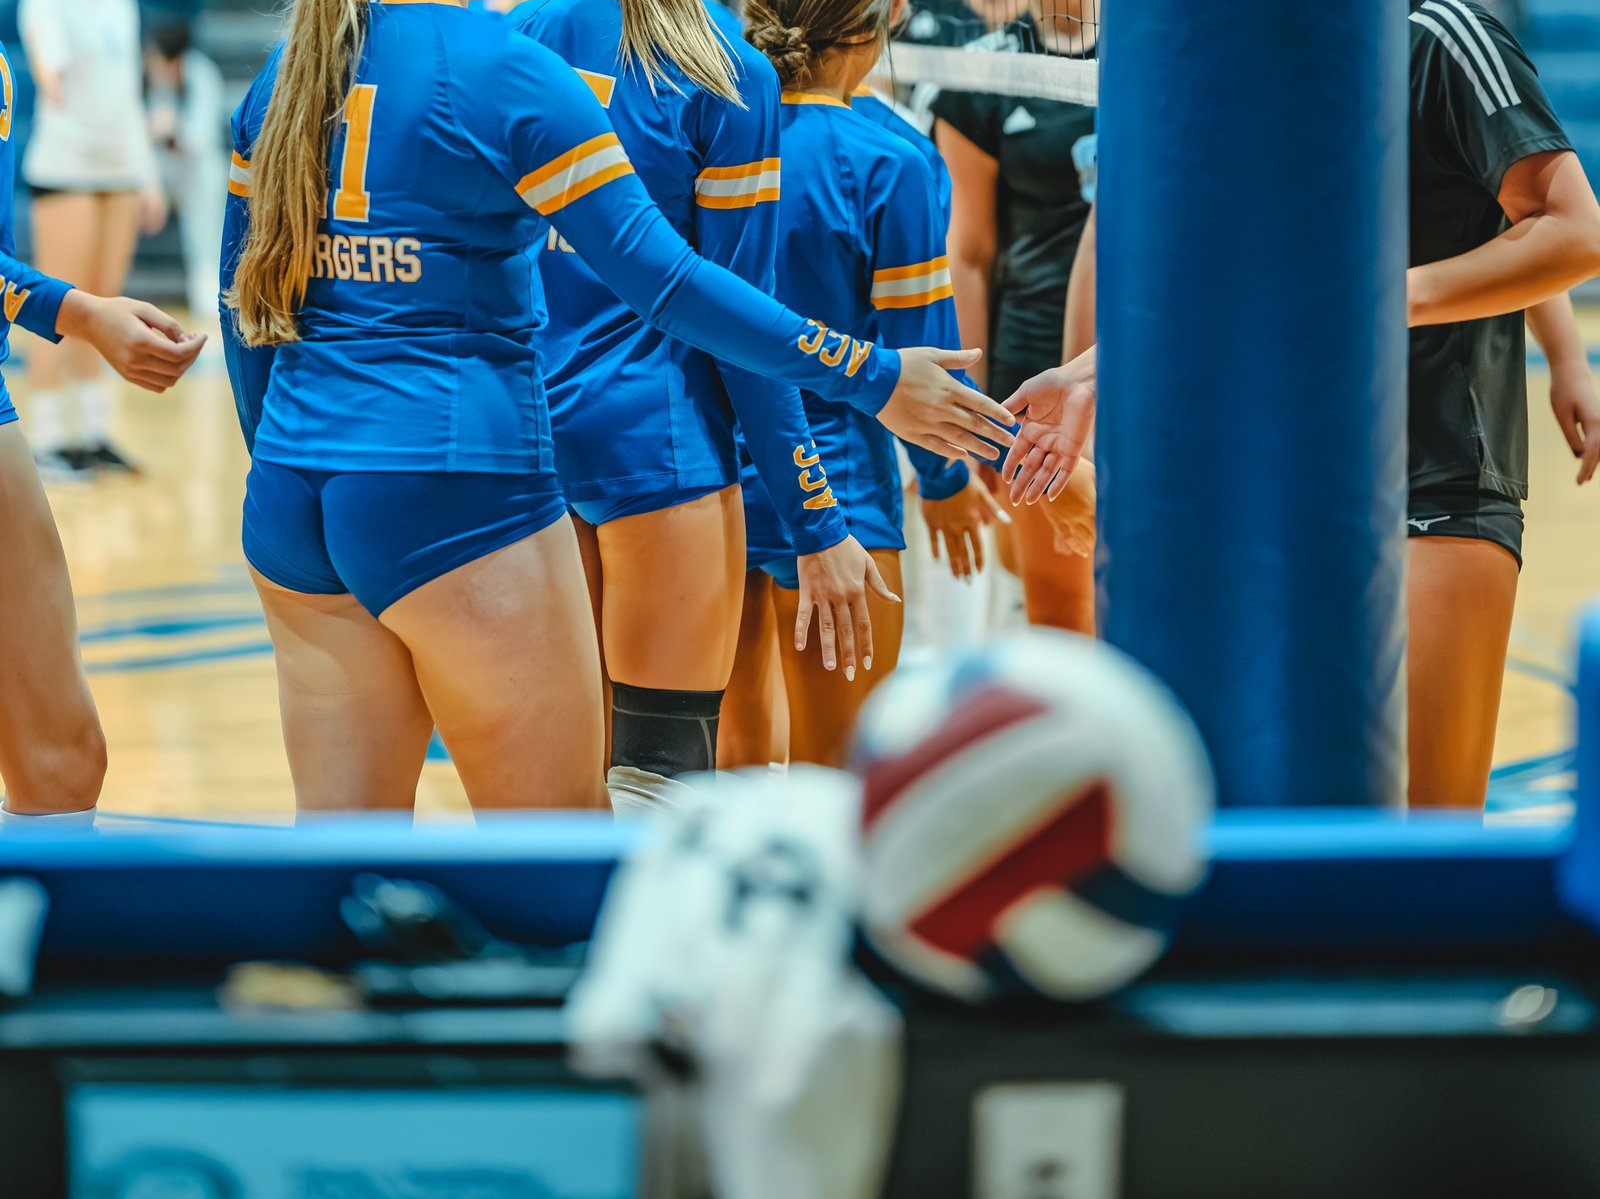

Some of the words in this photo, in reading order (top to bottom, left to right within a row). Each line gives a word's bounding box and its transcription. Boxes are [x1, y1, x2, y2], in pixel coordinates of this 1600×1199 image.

[319, 83, 379, 223] 1
[308, 232, 423, 283] RGERS
[797, 319, 875, 378] ACC
[792, 439, 838, 510] ACC
